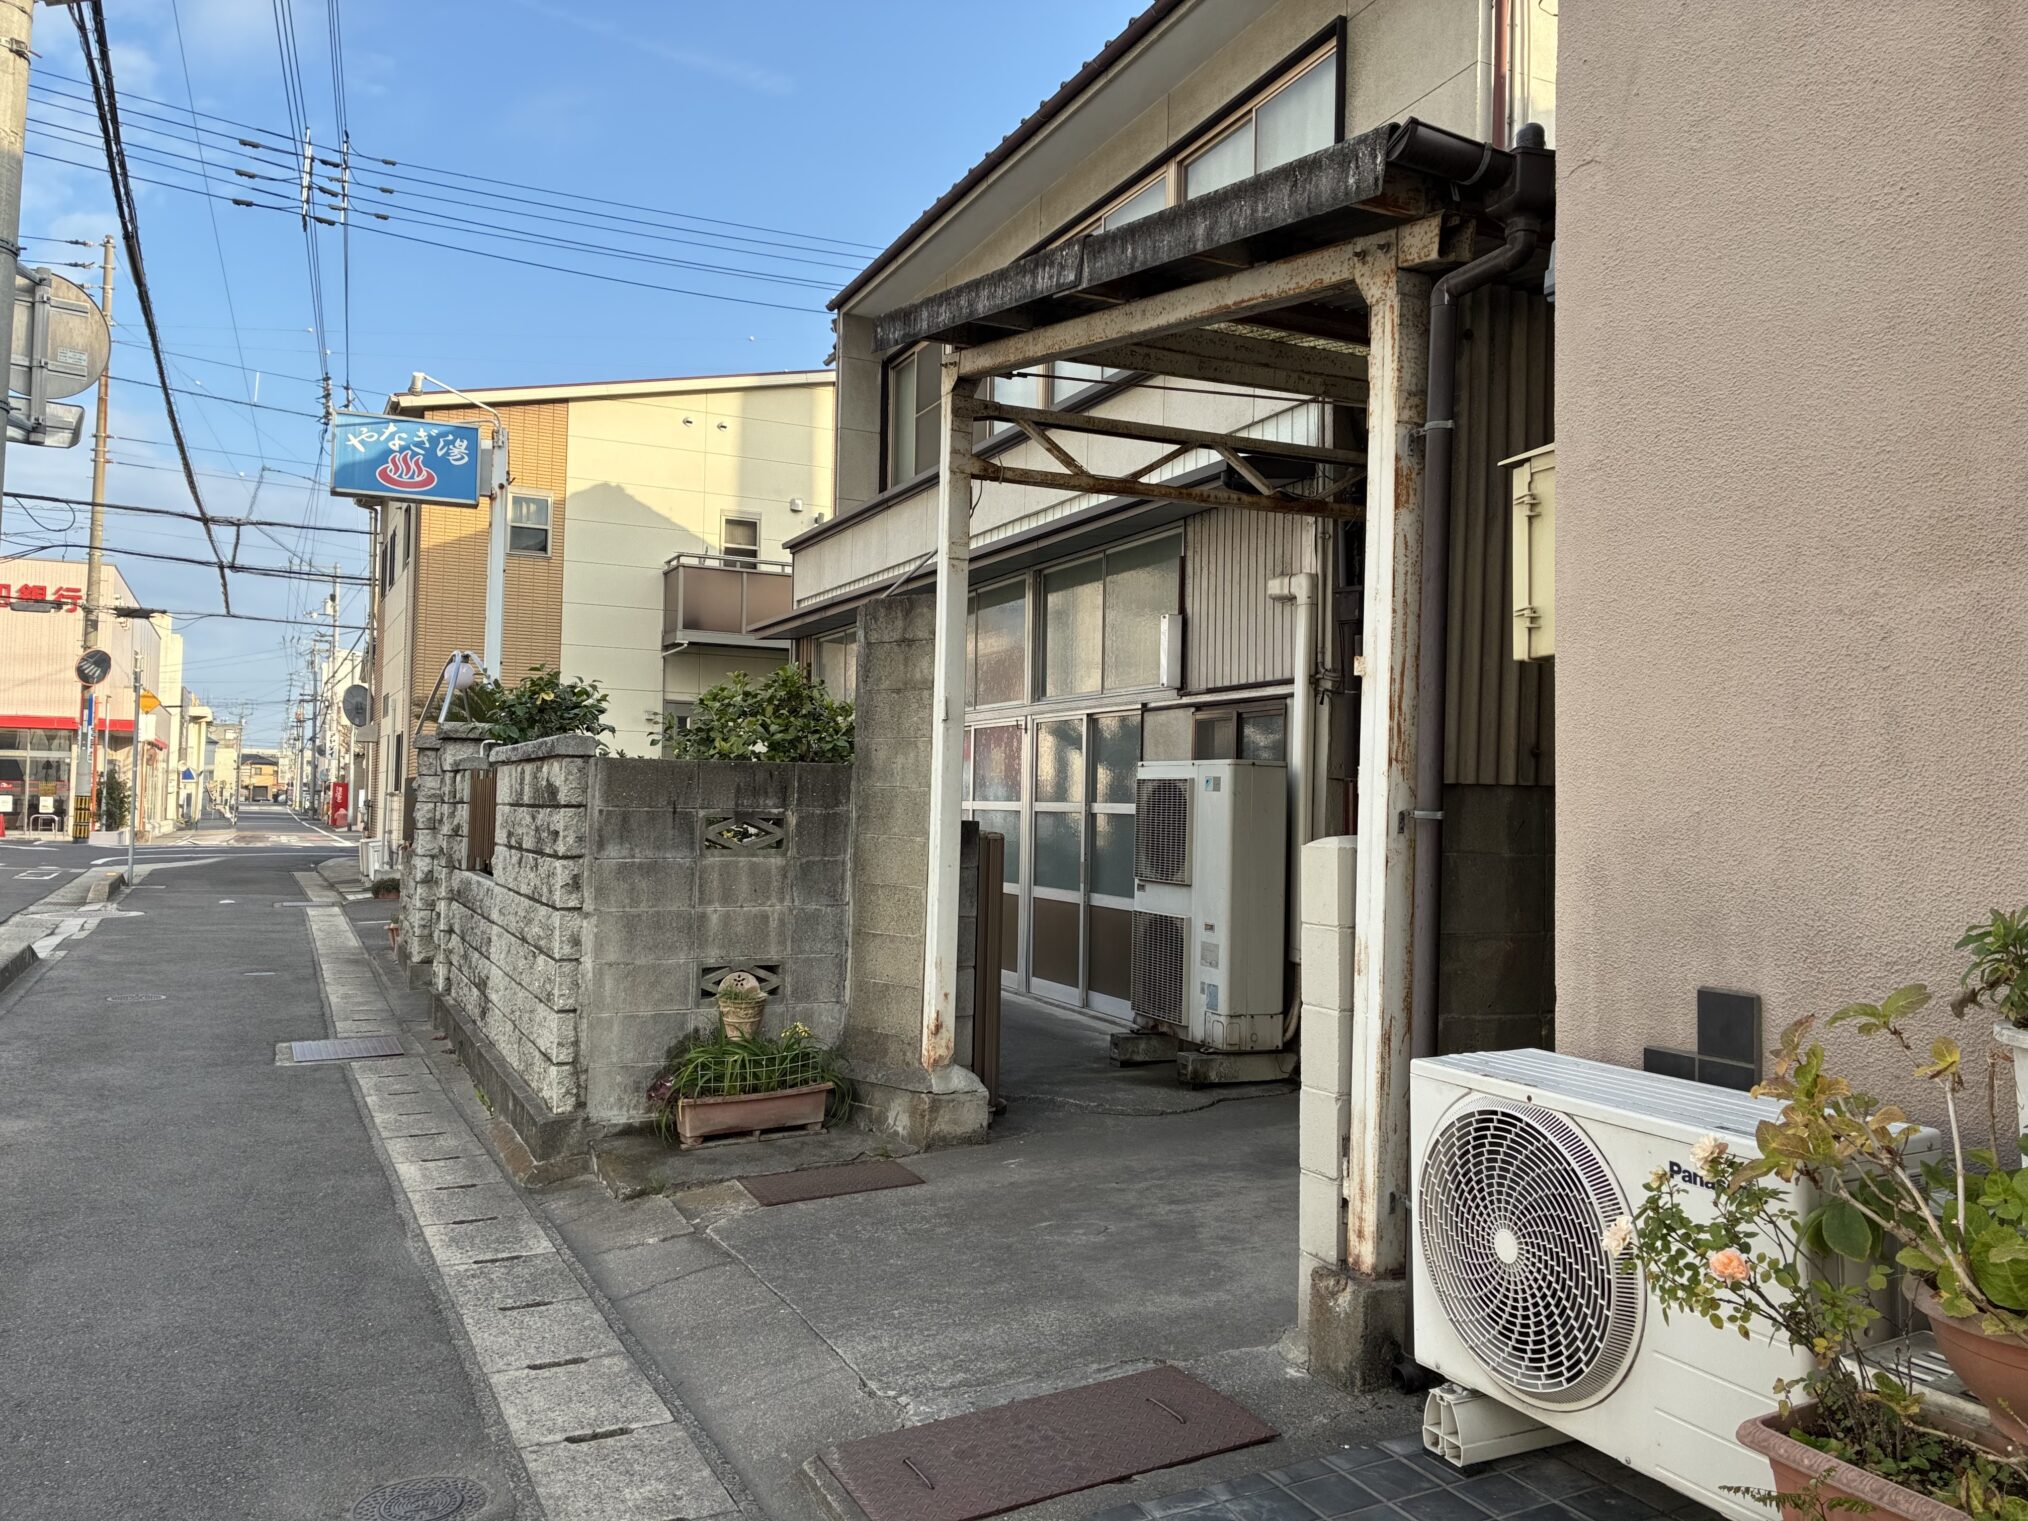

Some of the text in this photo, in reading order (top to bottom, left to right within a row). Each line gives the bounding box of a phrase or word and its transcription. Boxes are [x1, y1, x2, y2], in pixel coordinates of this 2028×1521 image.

[345, 422, 469, 465] やなぎ湯
[1669, 1160, 1716, 1190] Pana
